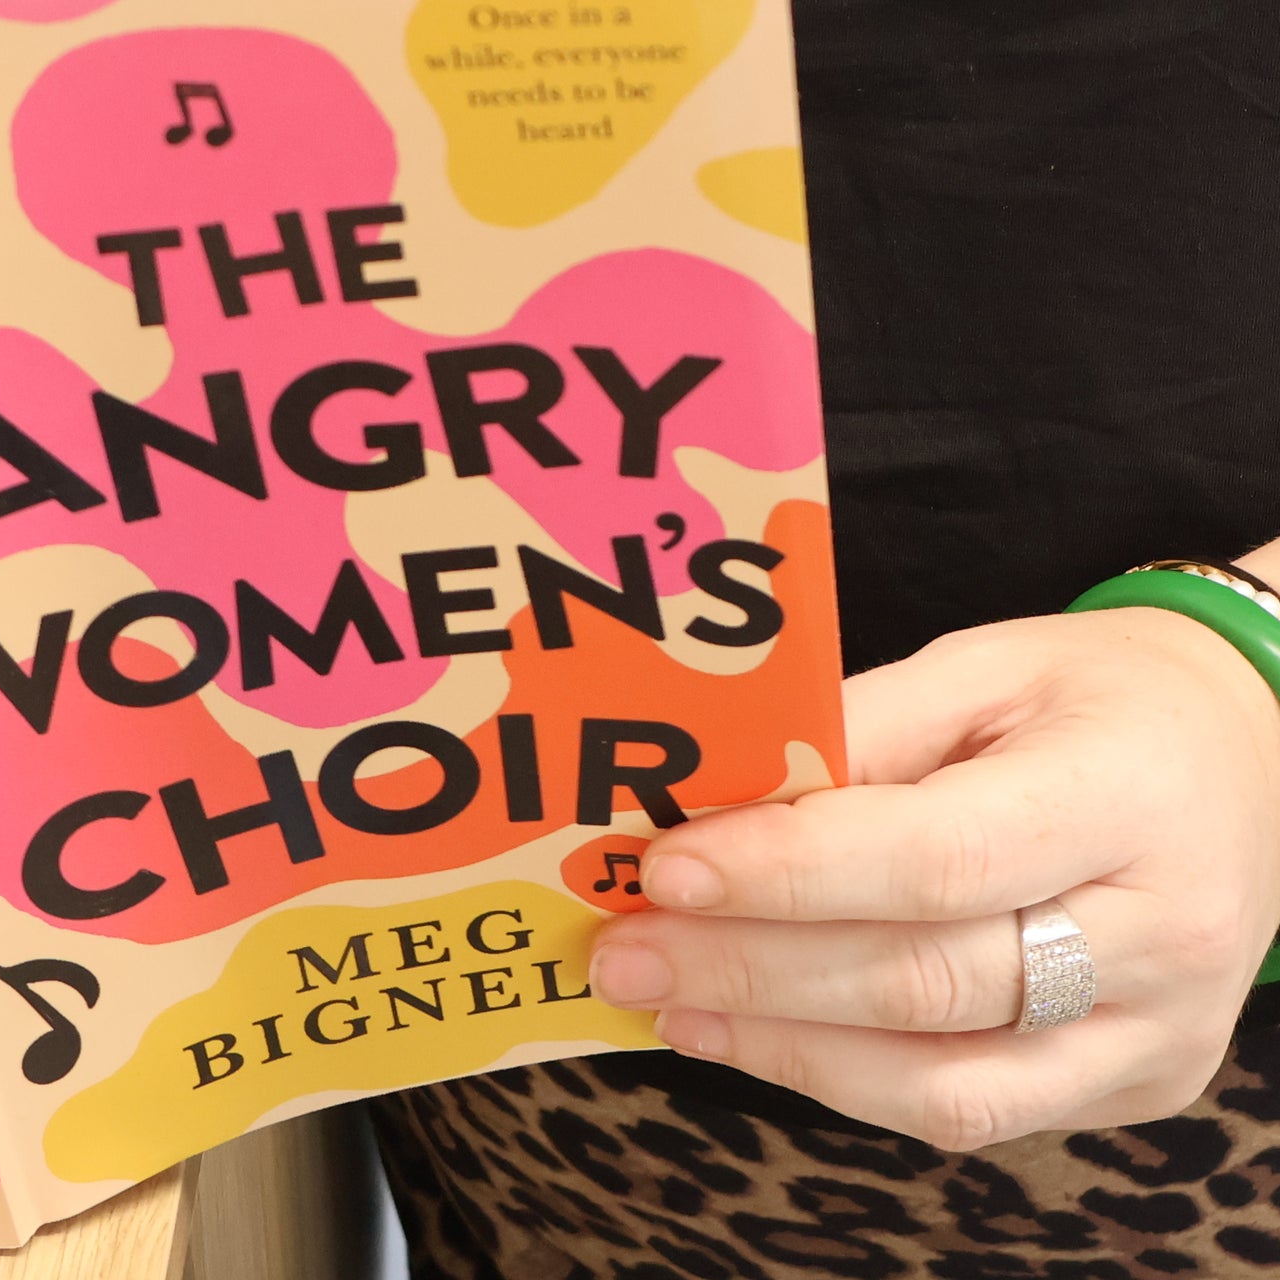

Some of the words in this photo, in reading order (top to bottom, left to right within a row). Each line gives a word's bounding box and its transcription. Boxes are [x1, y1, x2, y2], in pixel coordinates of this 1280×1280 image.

[468, 4, 557, 31] Once
[568, 0, 602, 26] in
[612, 6, 632, 26] a
[424, 44, 524, 70] while,
[532, 43, 686, 70] everyone
[467, 79, 564, 107] needs
[572, 83, 607, 103] to
[615, 77, 653, 102] be
[517, 114, 614, 142] heard
[97, 204, 420, 327] THE
[21, 712, 702, 920] CHOIR
[288, 909, 535, 994] MEG
[183, 960, 591, 1090] BIGNEL
